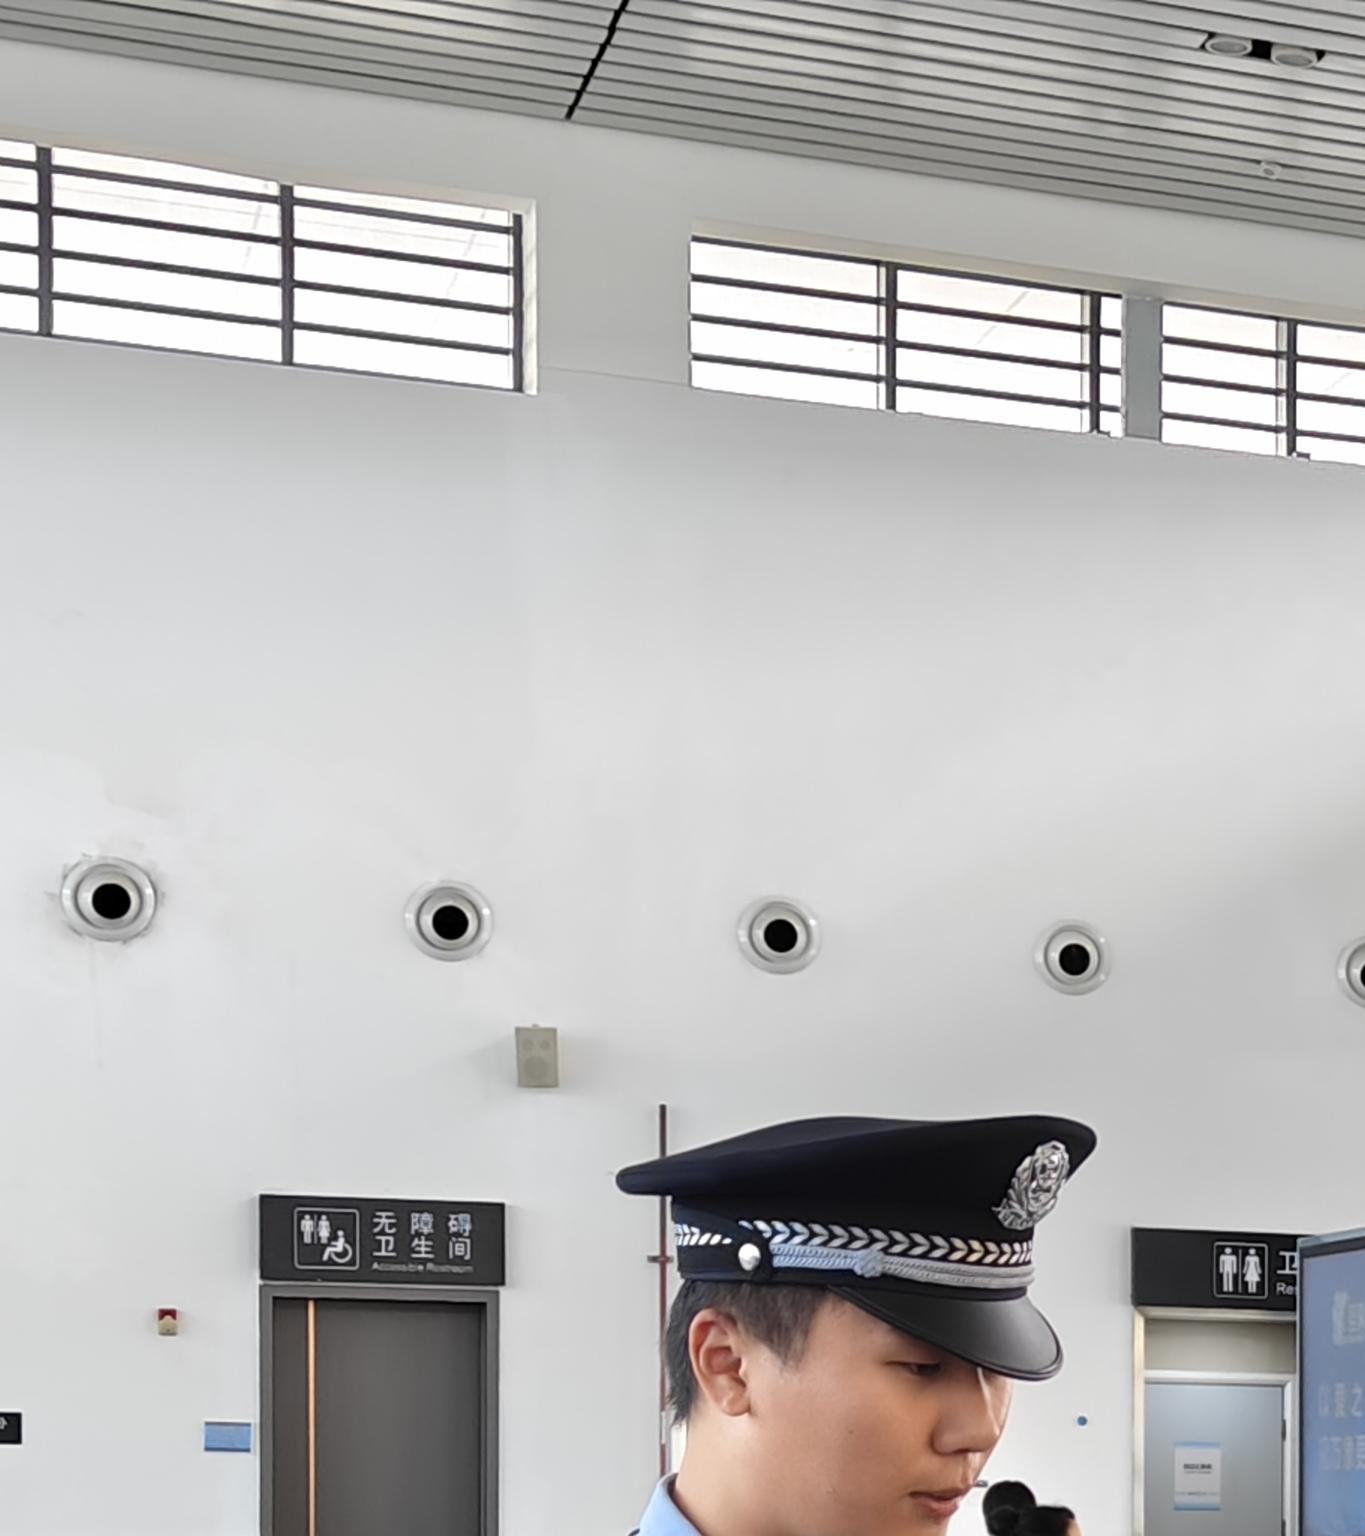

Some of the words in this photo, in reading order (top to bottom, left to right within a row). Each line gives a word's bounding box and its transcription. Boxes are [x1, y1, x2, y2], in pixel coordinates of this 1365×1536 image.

[372, 1211, 472, 1237] 无障碍
[372, 1235, 471, 1260] 卫生间
